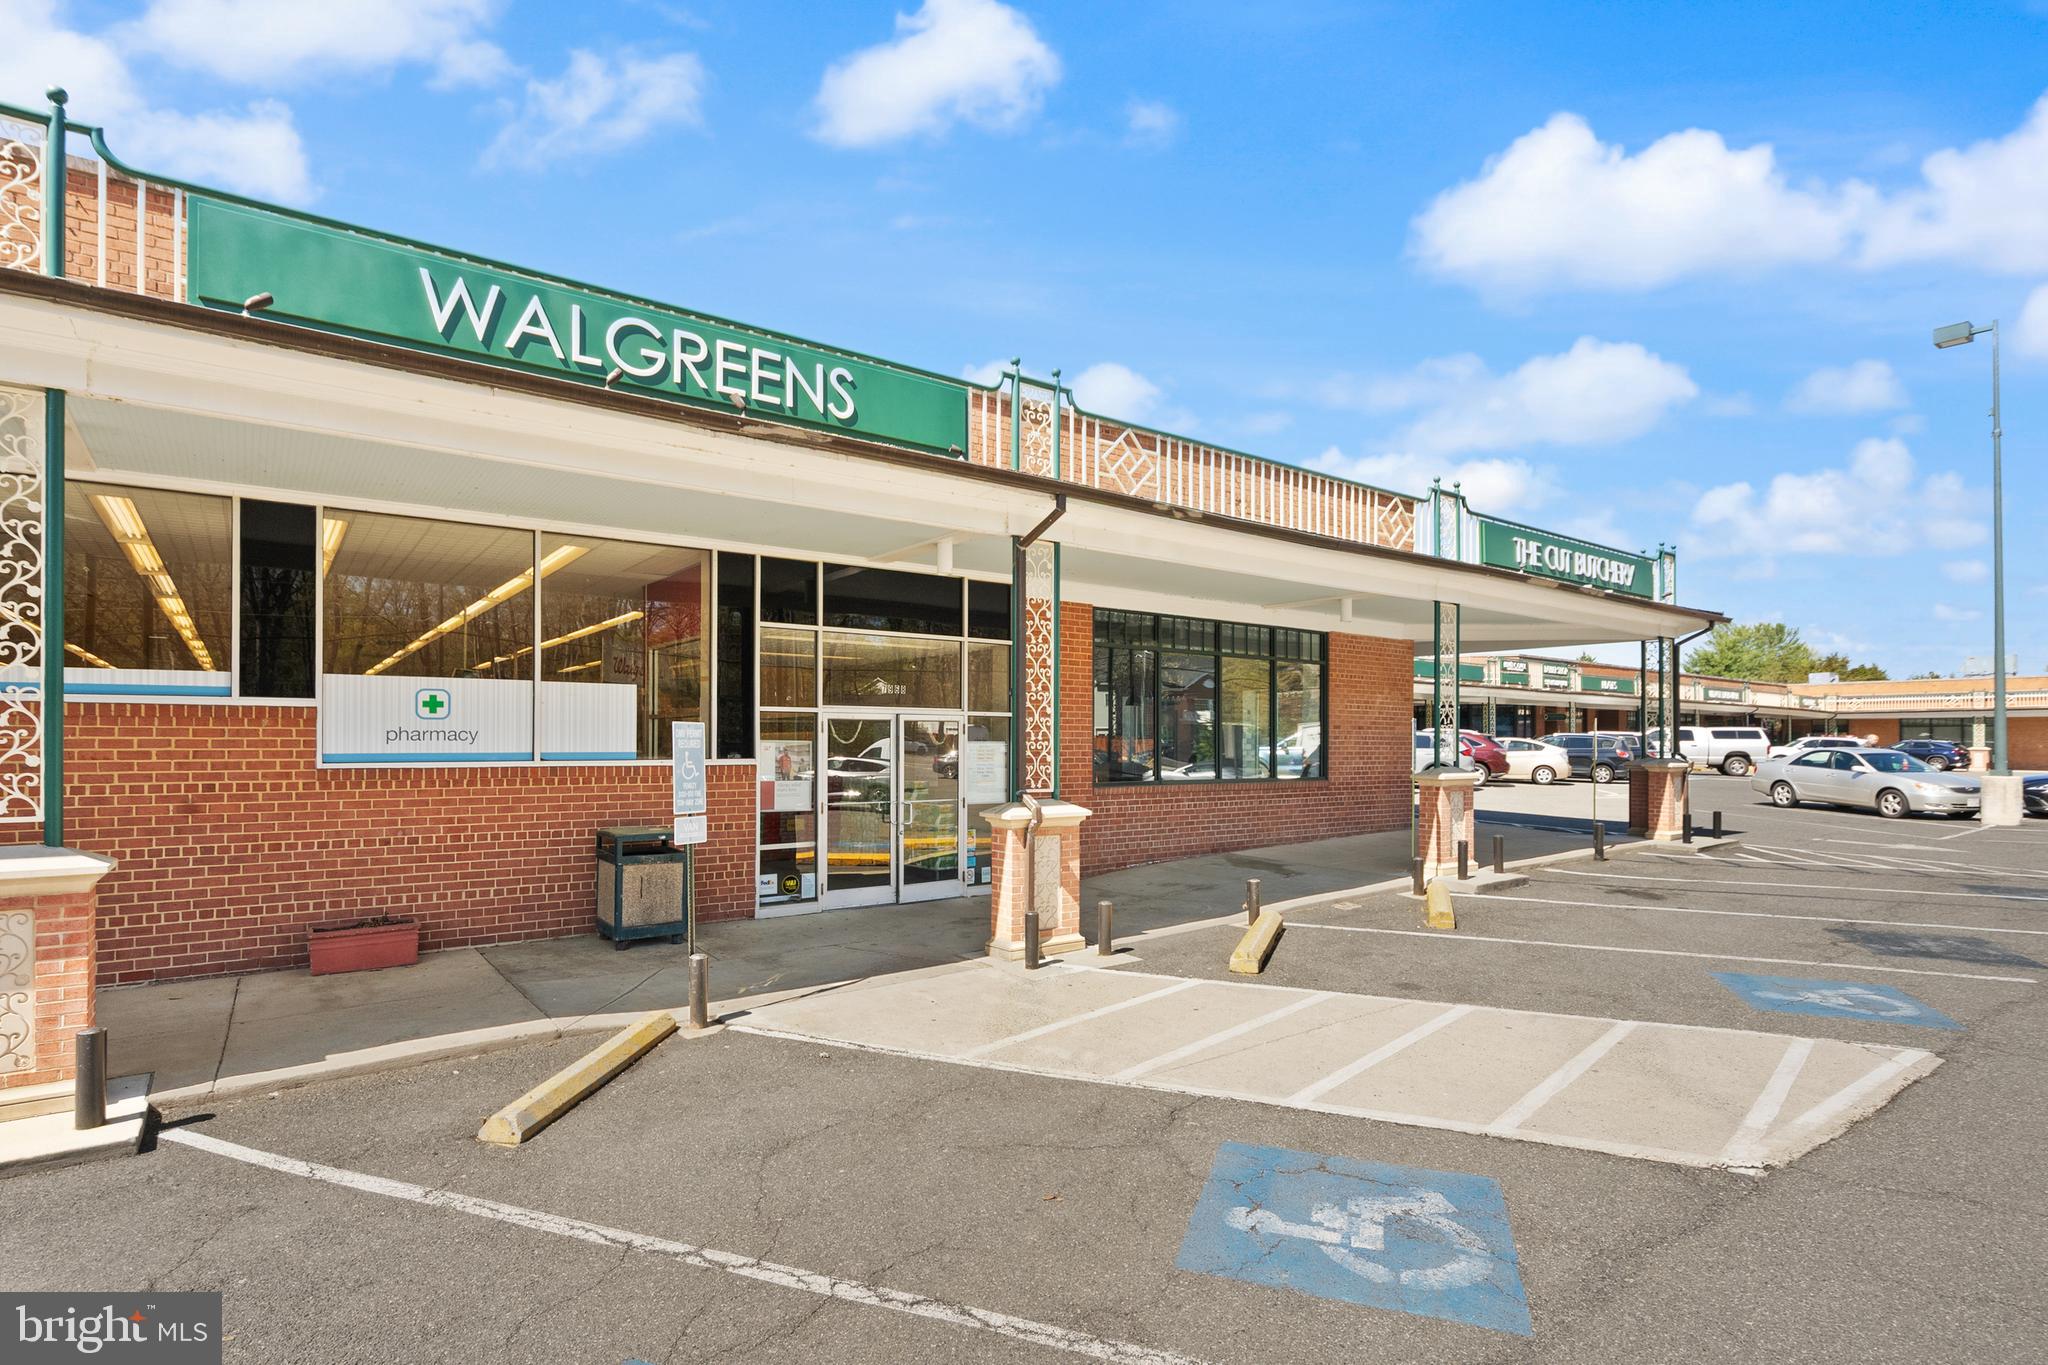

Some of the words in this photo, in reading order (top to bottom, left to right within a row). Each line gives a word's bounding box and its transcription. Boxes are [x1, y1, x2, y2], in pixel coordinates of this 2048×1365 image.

[419, 267, 857, 420] WALGREENS
[1512, 536, 1543, 567] THE
[1544, 545, 1573, 573] CUT
[1574, 551, 1636, 587] BUTCHERY
[386, 726, 479, 745] pharmacy
[683, 822, 699, 832] VAN
